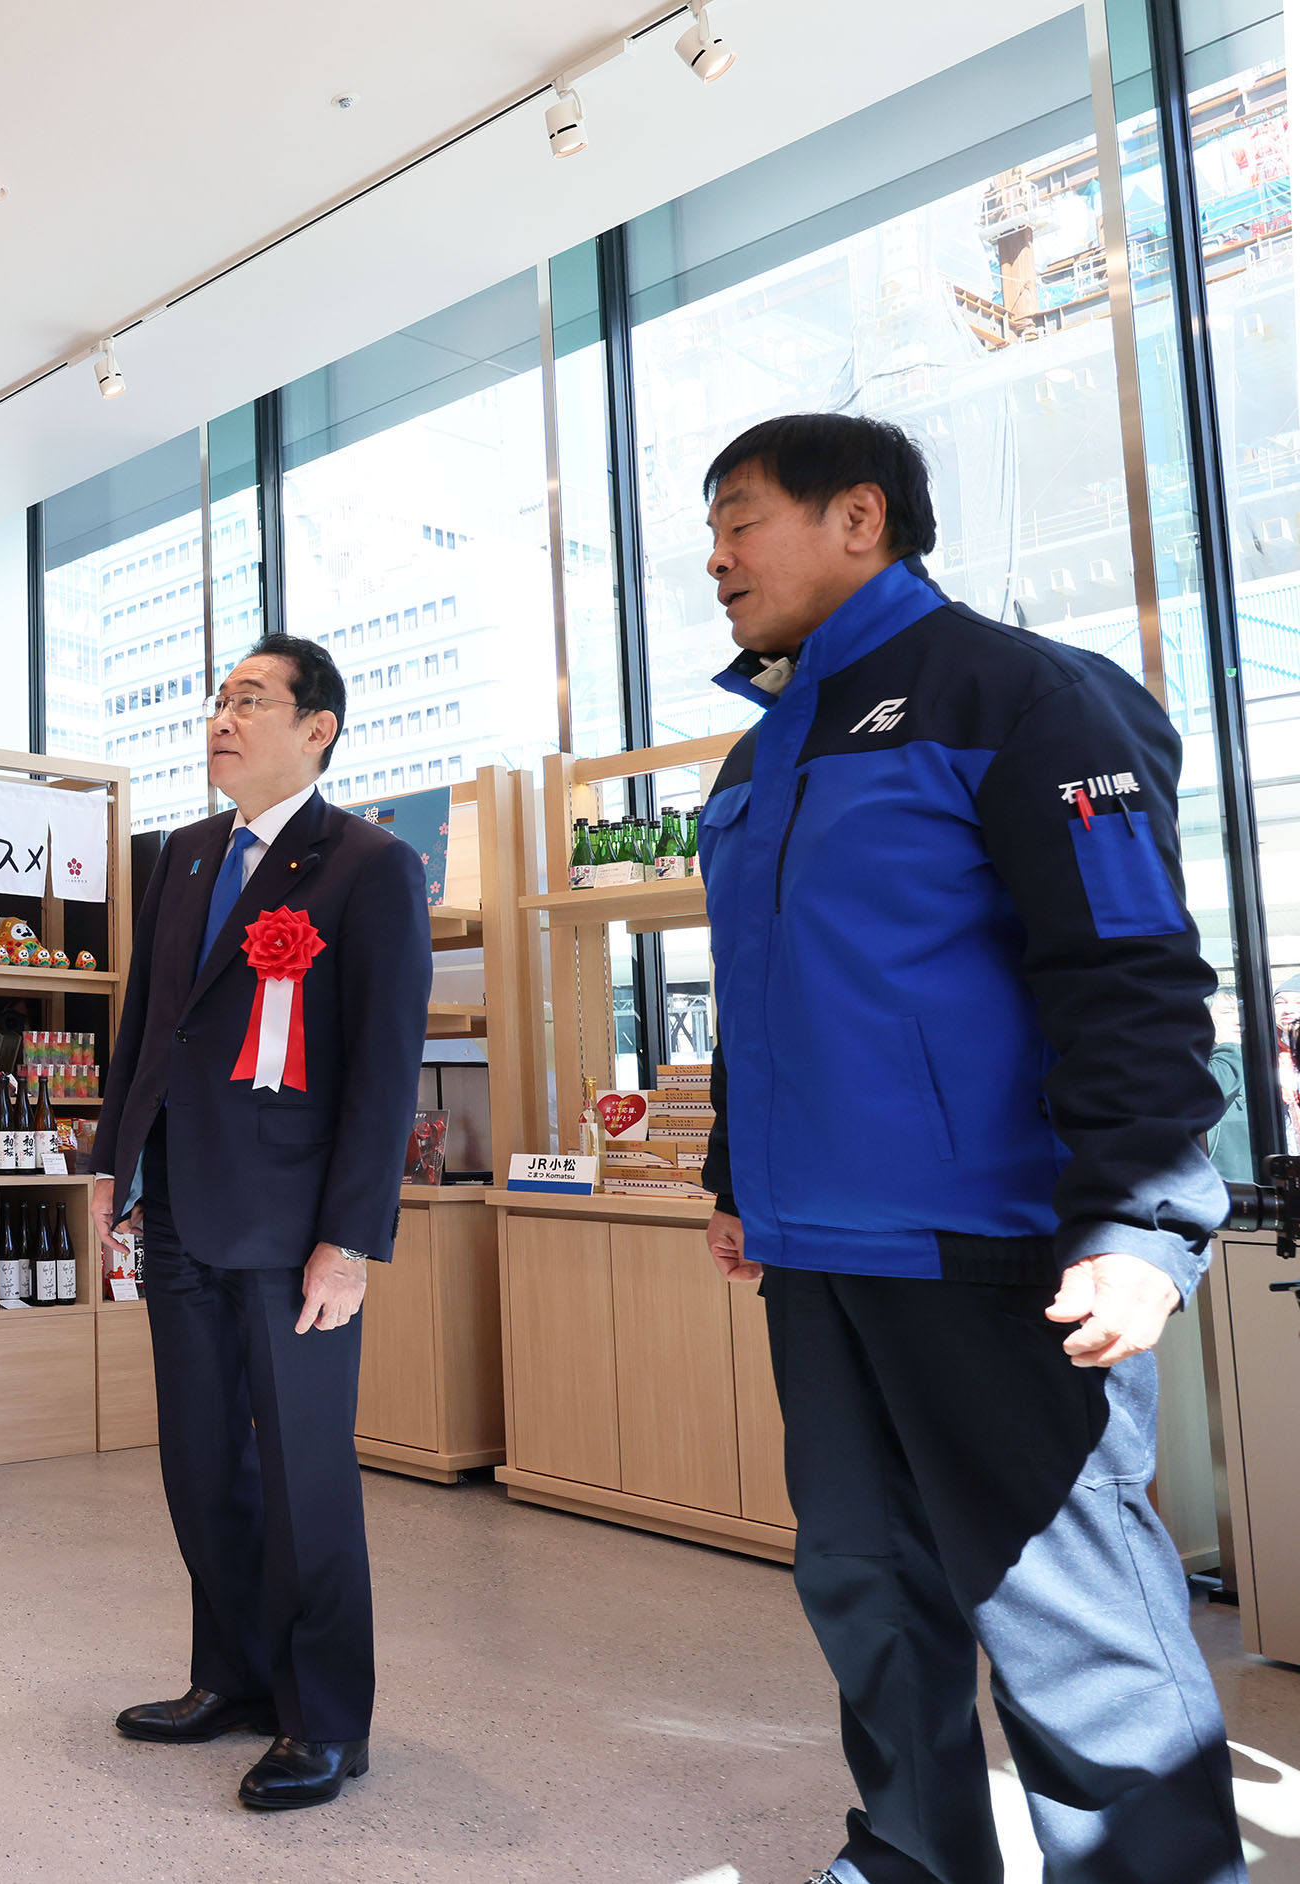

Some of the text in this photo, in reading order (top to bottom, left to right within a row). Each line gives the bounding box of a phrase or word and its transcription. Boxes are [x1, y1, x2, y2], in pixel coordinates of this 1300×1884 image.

[1058, 772, 1140, 804] 石川県
[545, 1172, 576, 1180] Komatsu
